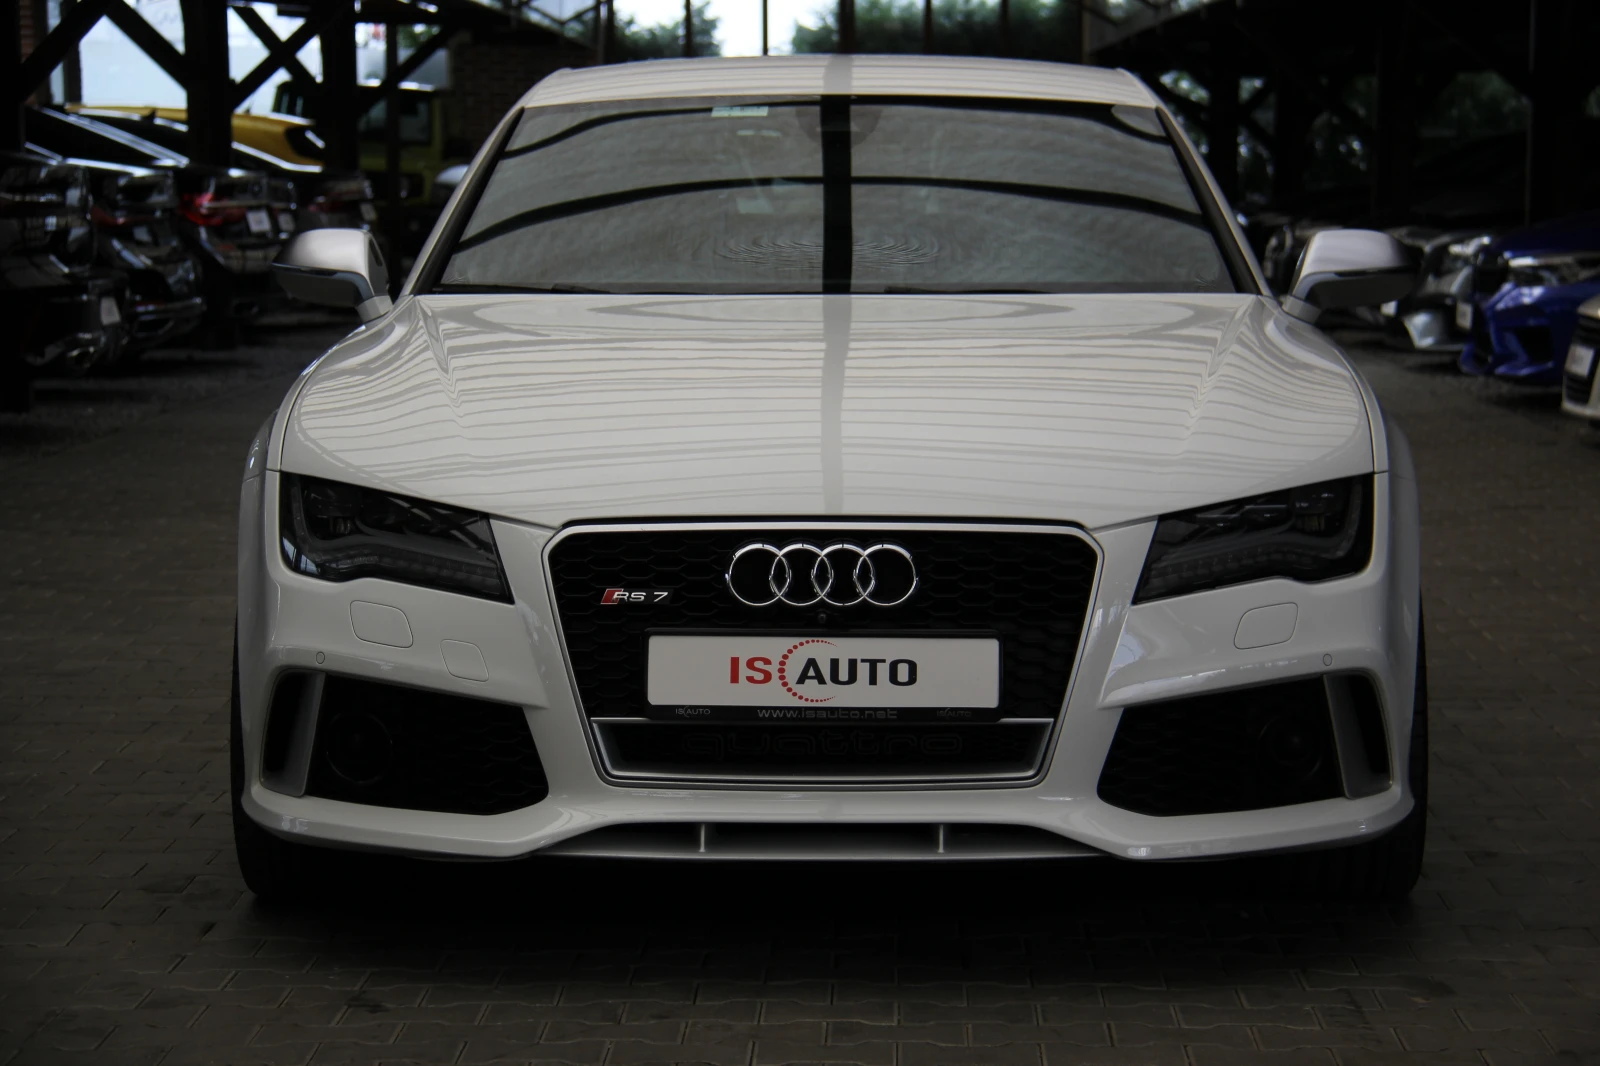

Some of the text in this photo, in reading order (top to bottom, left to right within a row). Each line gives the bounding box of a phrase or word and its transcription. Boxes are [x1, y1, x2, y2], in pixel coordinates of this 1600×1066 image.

[611, 591, 669, 602] RS 7
[730, 656, 918, 686] IS AUTO
[757, 708, 898, 719] www.isauto.net
[681, 729, 963, 761] quattro
